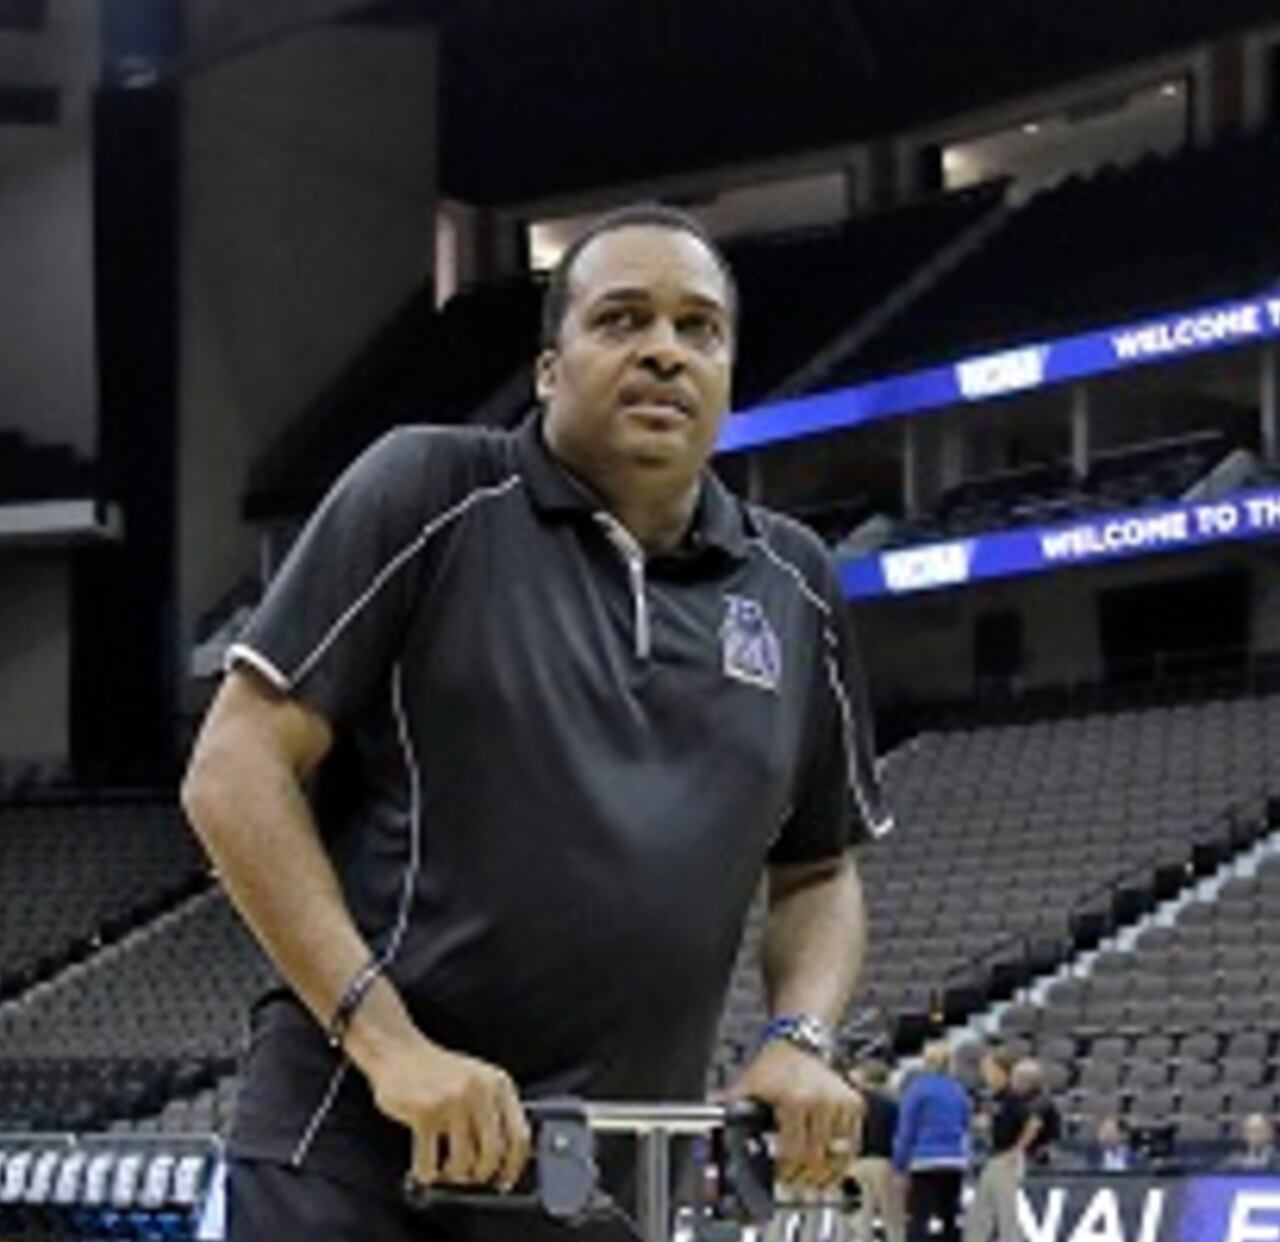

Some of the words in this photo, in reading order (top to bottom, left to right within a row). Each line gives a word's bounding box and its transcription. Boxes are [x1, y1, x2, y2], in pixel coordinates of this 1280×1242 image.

[1112, 304, 1260, 359] WELCOME
[1040, 510, 1188, 560] WELCOME
[1195, 502, 1238, 534] TO
